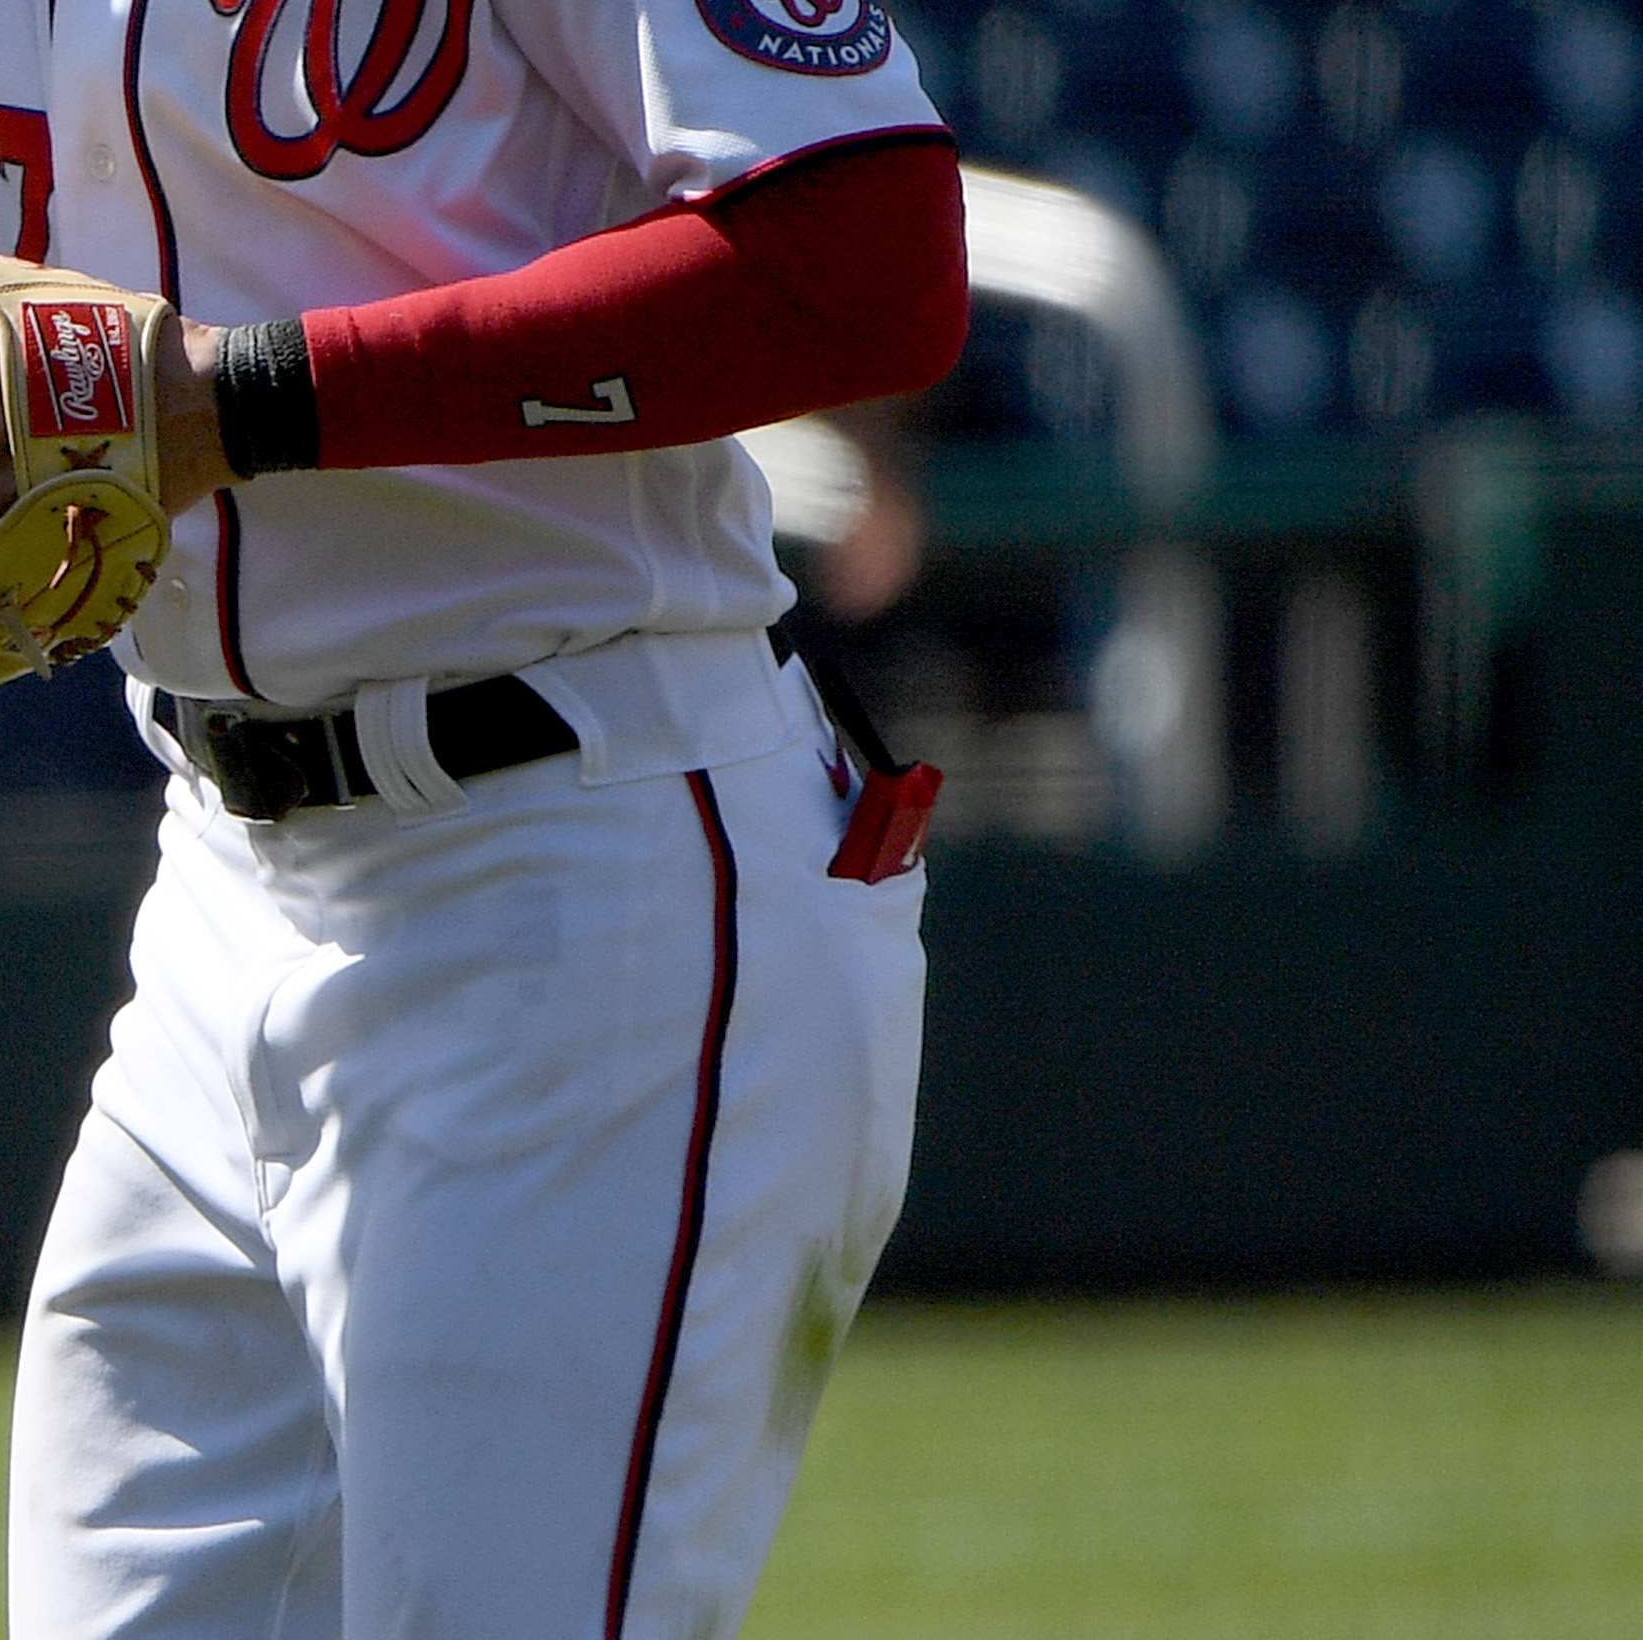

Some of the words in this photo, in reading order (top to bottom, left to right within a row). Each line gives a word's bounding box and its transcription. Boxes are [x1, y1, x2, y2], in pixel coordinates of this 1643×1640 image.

[756, 2, 885, 66] NATIONALS
[49, 309, 100, 422] Rawlings
[520, 374, 638, 428] 7
